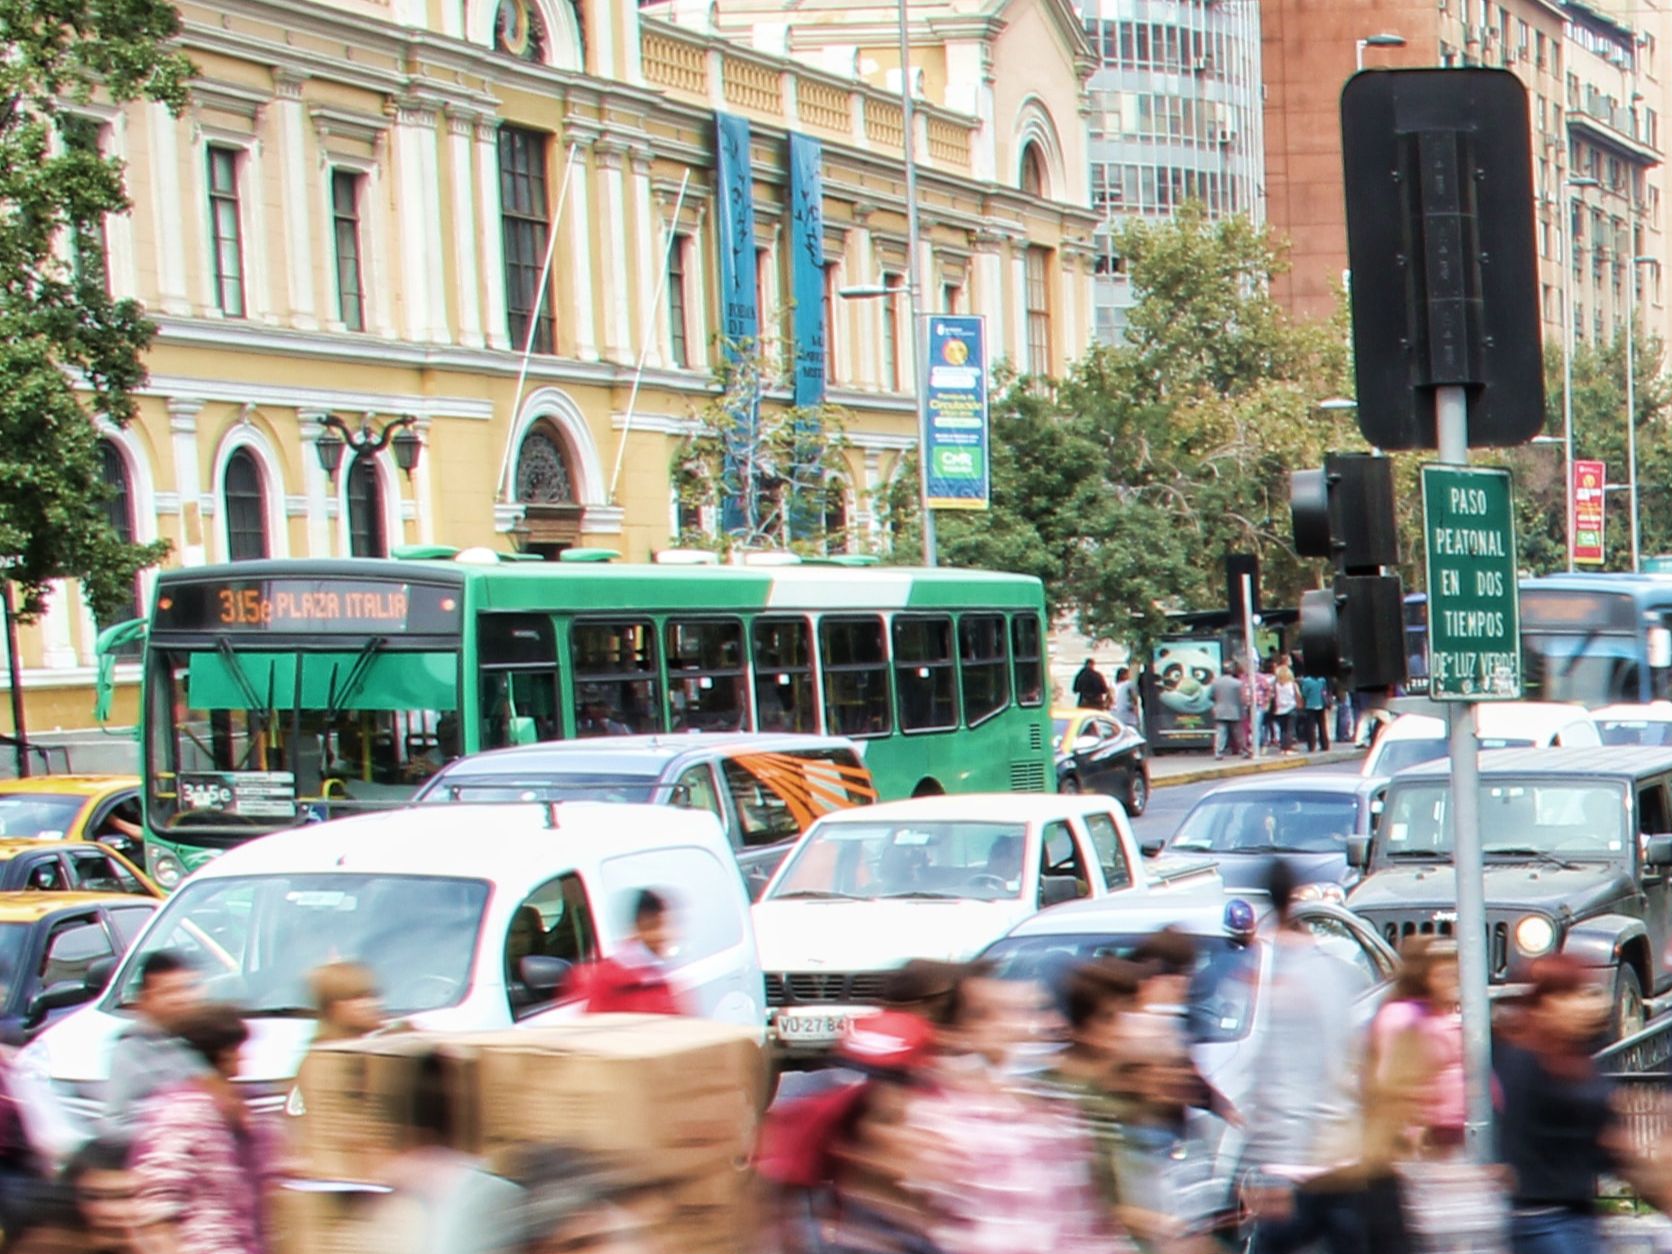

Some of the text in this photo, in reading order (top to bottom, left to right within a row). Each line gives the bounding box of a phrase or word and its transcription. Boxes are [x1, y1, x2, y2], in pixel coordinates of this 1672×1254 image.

[1451, 487, 1487, 516] PASO
[1436, 527, 1506, 557] PEATONAL
[1442, 569, 1503, 597] EN DOS
[219, 588, 407, 623] 315e PLAZA ITALIA
[1443, 610, 1504, 638] TIEMPOS
[1432, 652, 1518, 678] DE LUZ VERDE
[182, 783, 232, 802] 315e
